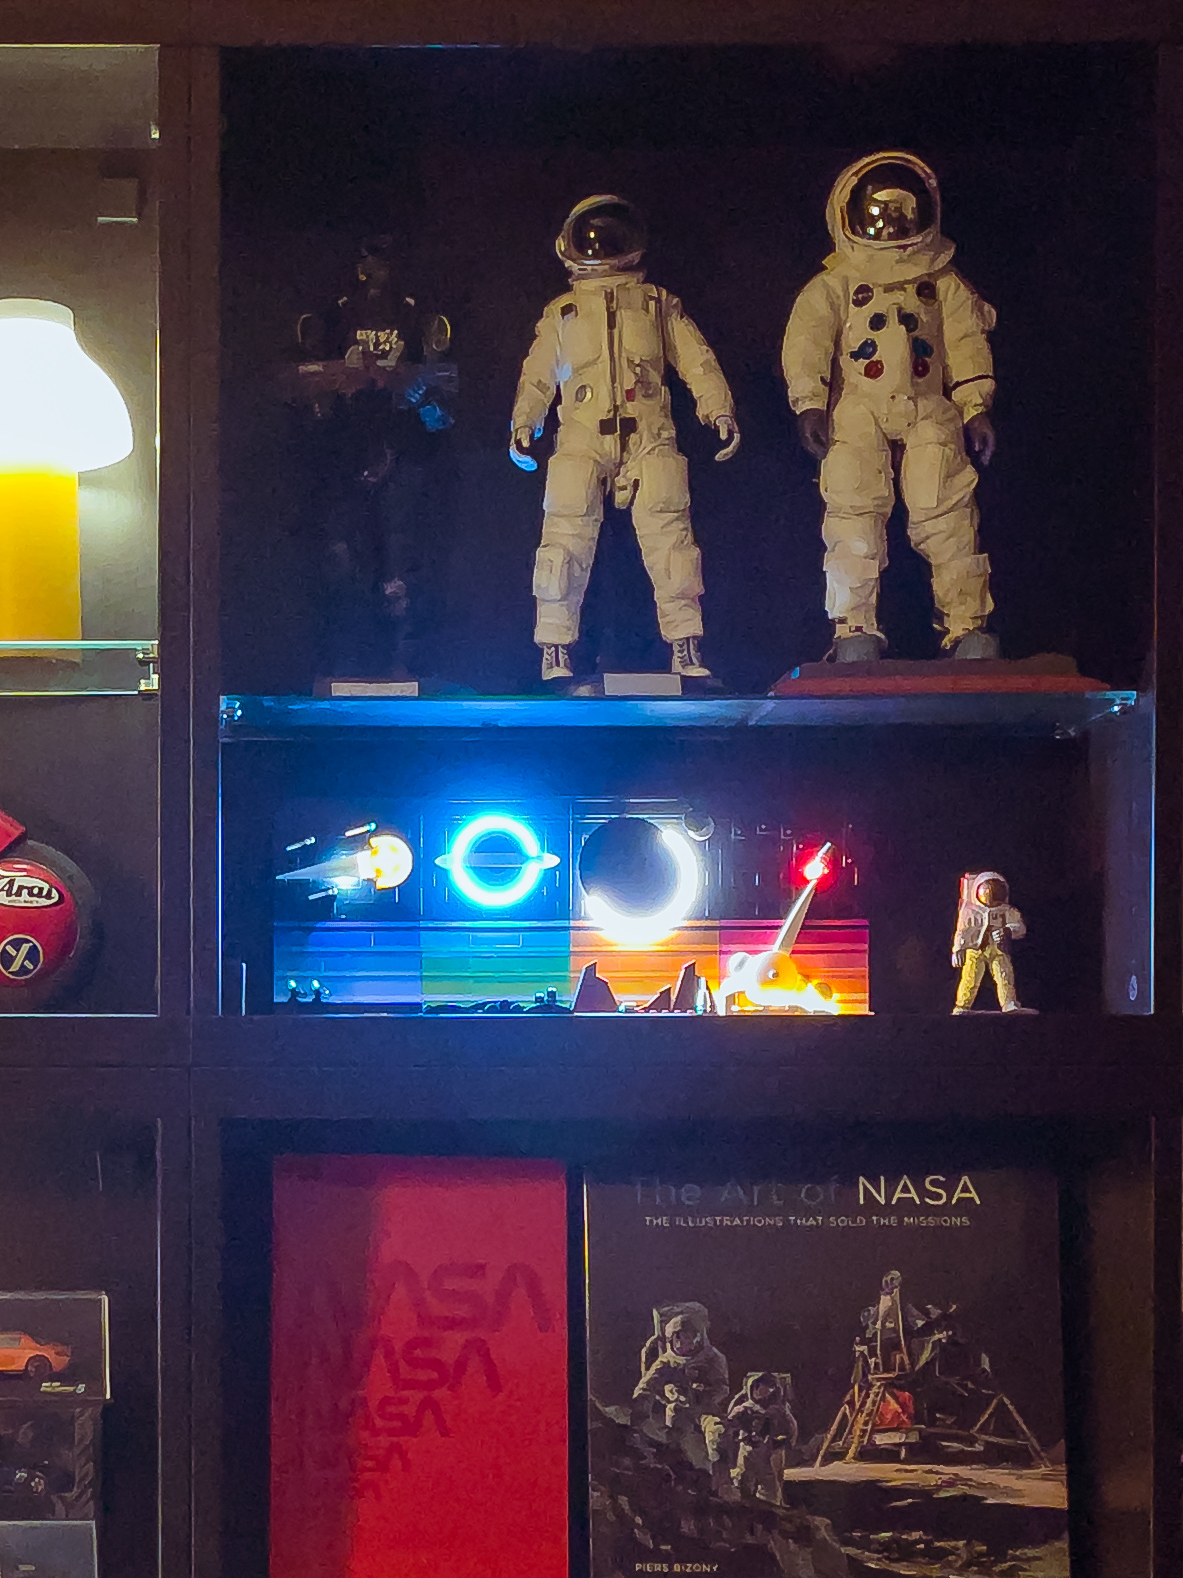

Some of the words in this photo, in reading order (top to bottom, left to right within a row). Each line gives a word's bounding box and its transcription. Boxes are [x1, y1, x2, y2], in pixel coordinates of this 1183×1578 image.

[858, 1174, 981, 1206] NASA
[644, 1215, 670, 1227] THE
[675, 1215, 784, 1227] ILLUSTRATIONS
[789, 1215, 823, 1227] THAT
[828, 1215, 866, 1227] SOLD
[872, 1215, 898, 1227] THE
[903, 1215, 971, 1227] MISSIONS
